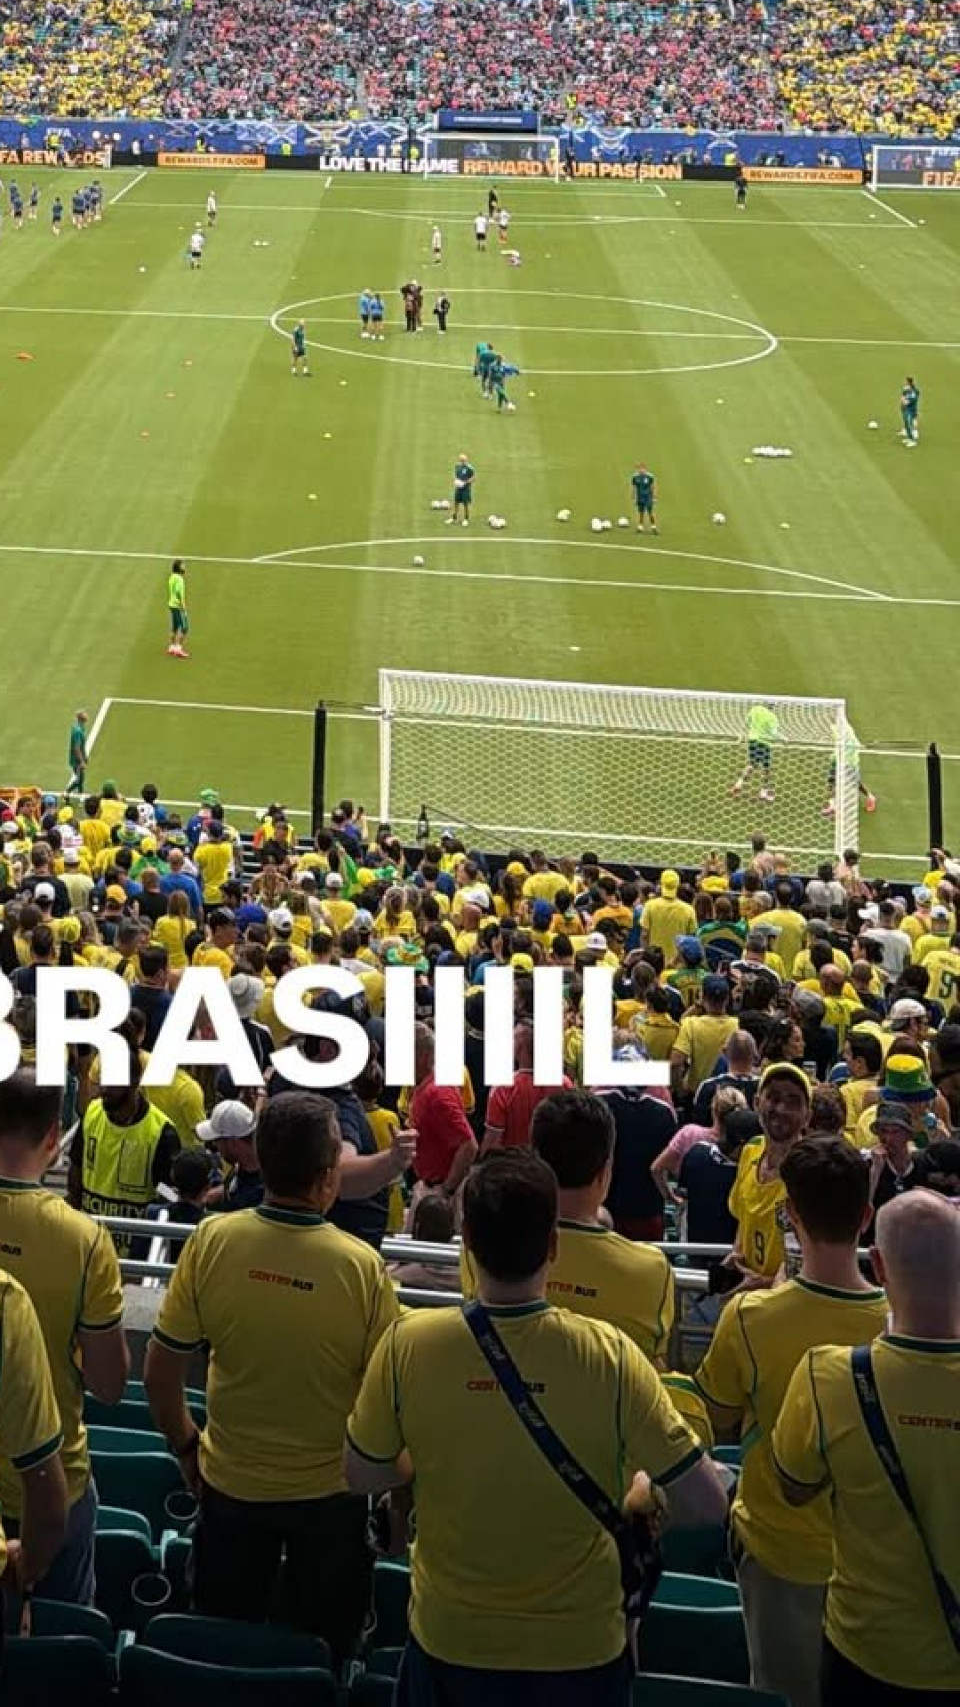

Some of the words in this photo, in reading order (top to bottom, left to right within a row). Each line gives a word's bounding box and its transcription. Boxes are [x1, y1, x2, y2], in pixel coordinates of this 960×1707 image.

[320, 155, 366, 172] LOVE
[367, 157, 402, 173] THE
[403, 157, 459, 173] GAME
[463, 158, 542, 175] REWARD
